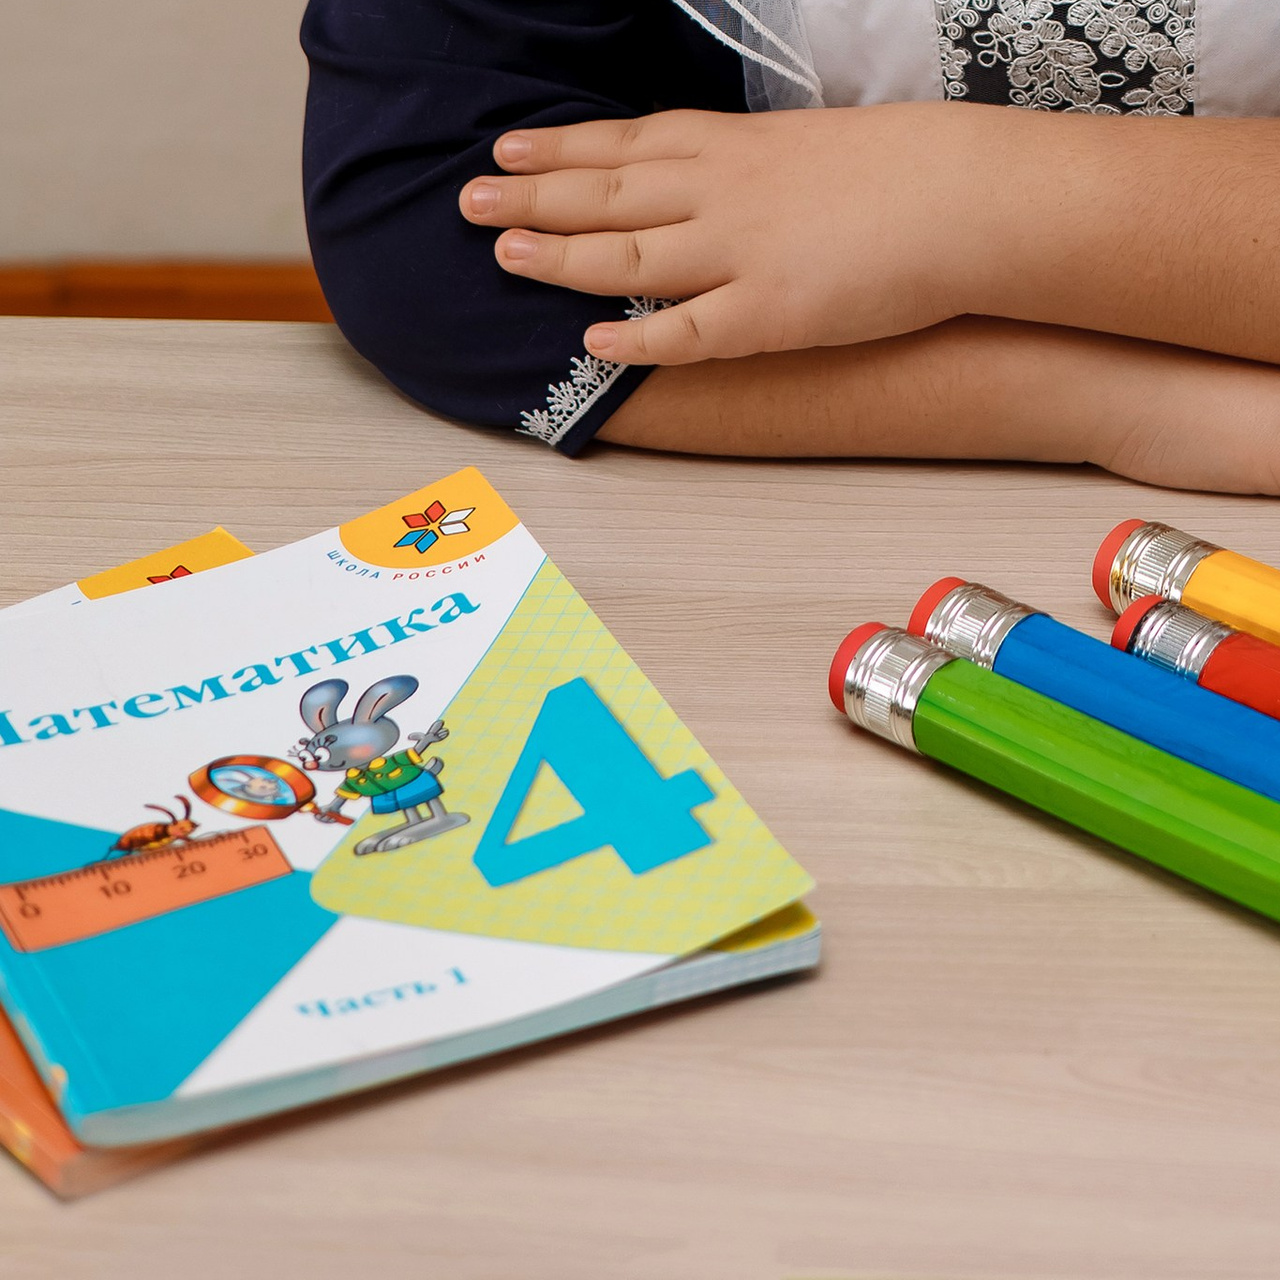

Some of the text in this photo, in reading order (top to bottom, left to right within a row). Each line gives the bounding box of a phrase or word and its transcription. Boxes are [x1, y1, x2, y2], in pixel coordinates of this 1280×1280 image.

[326, 549, 486, 581] ШКОЛА РОССИИ
[472, 676, 717, 888] 4
[99, 880, 132, 899] 10
[171, 860, 207, 879] 20
[237, 842, 269, 861] 30
[296, 981, 438, 1017] Часть
